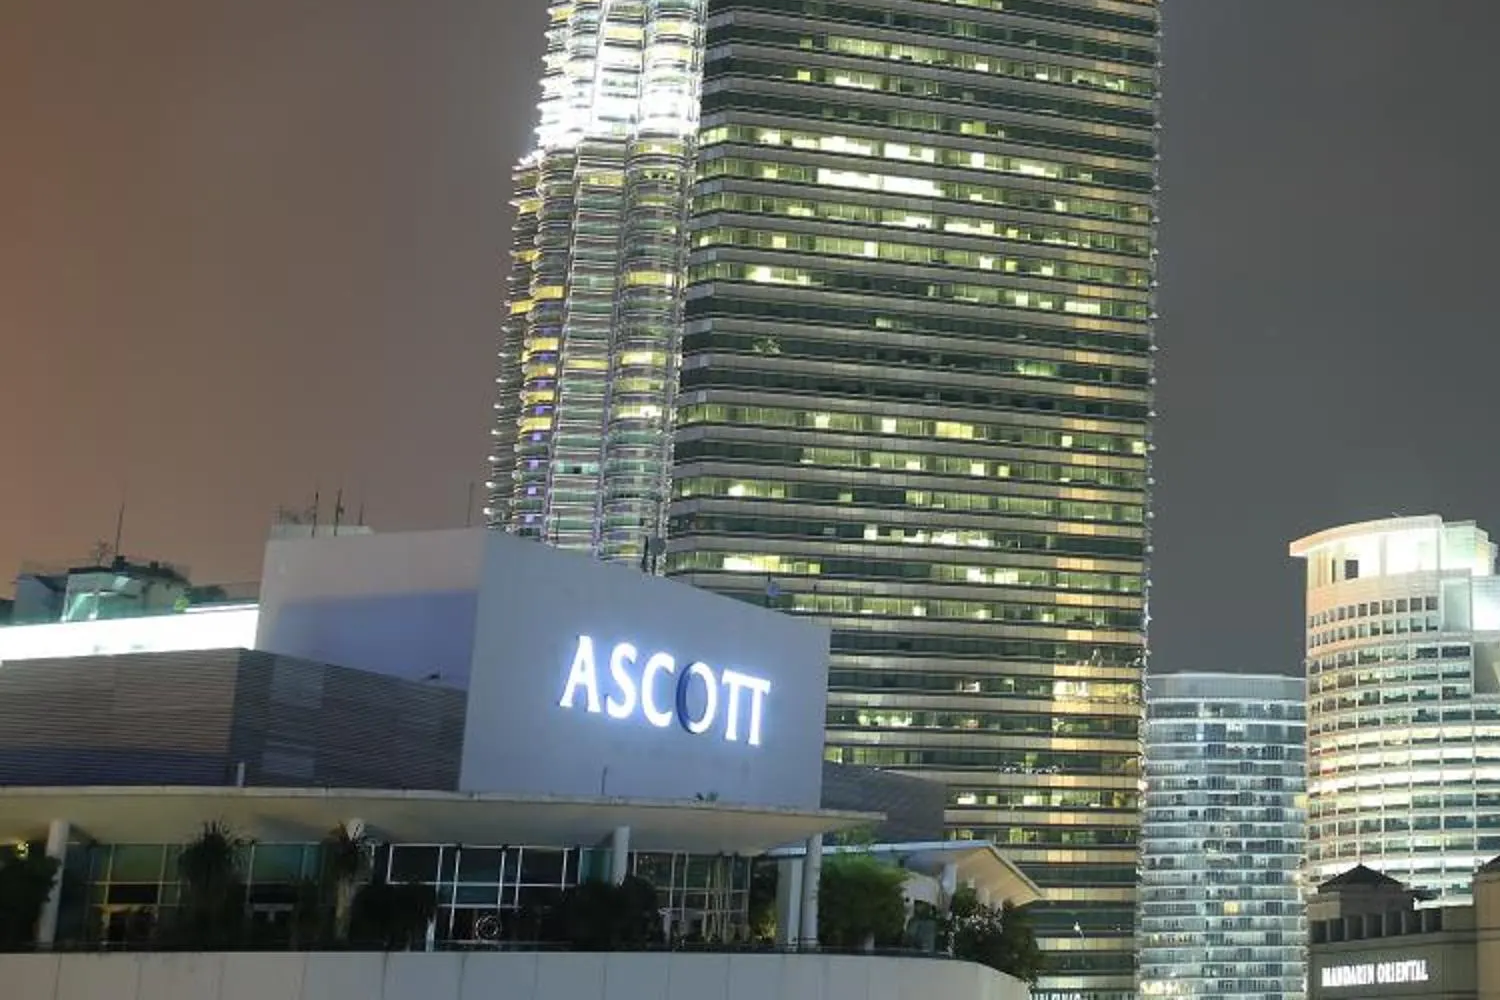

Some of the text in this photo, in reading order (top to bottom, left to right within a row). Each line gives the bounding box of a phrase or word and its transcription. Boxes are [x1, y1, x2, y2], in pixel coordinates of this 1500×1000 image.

[559, 635, 771, 746] ASCOTT
[1322, 959, 1429, 987] MANDARIN ORIENTAL
